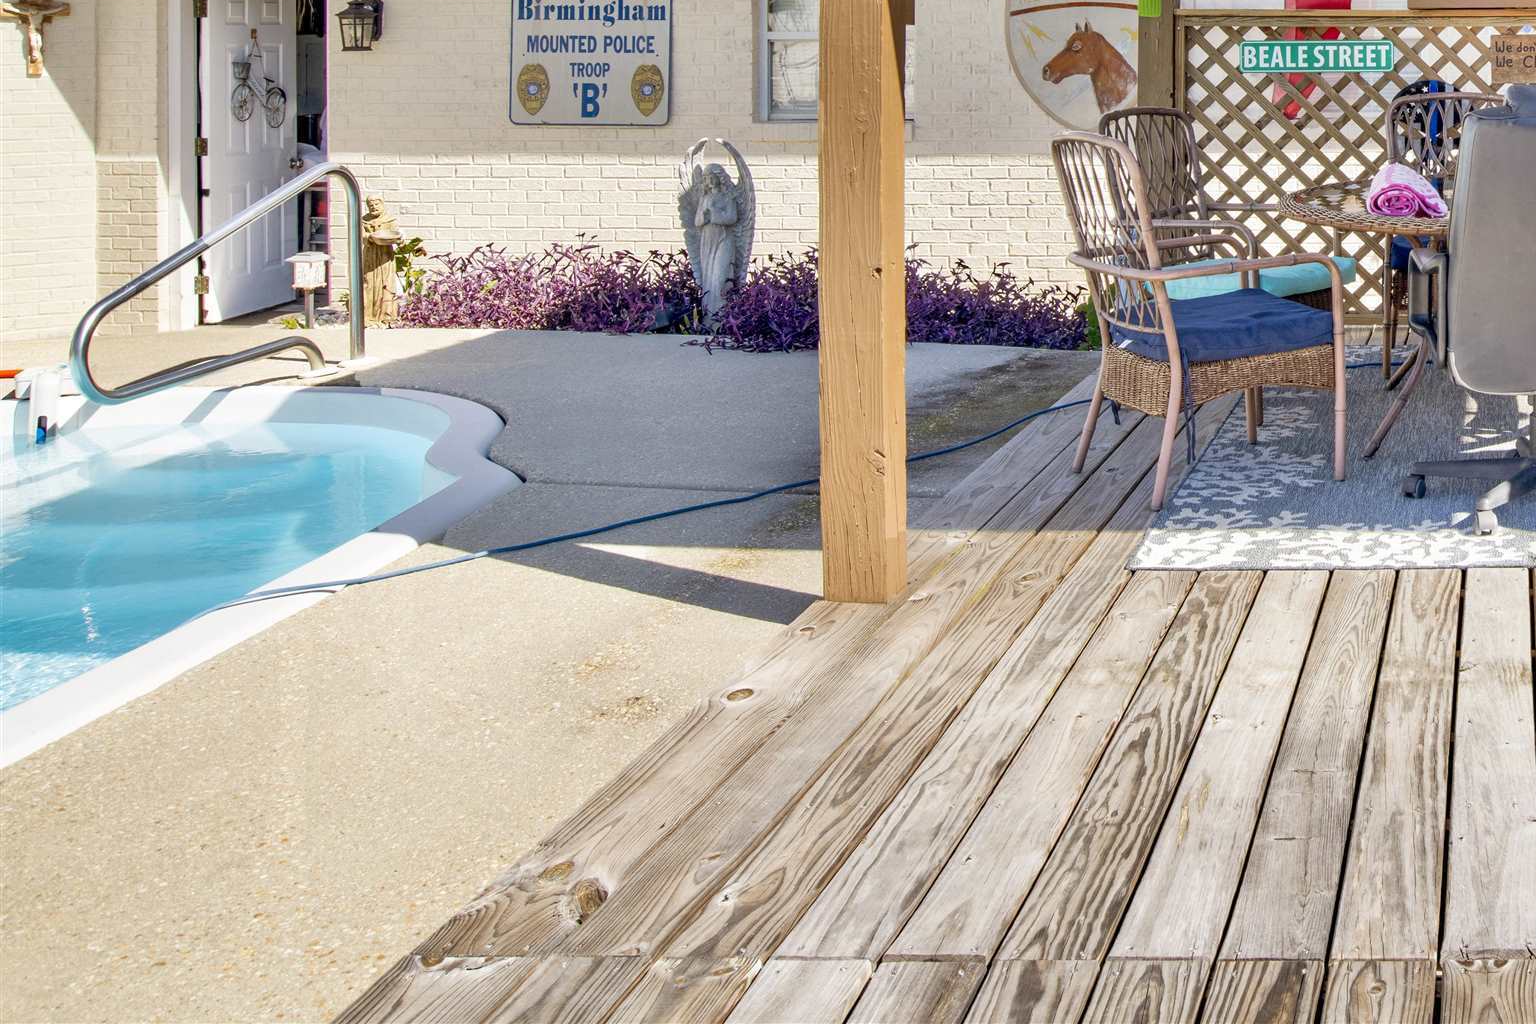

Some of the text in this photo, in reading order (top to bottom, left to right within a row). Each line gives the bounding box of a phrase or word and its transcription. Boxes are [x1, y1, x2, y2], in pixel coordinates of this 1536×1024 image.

[526, 35, 656, 54] MOUNTED POLICE
[1495, 40, 1513, 53] We
[1243, 45, 1390, 68] BEALE STREET
[1495, 55, 1513, 68] We
[569, 62, 610, 78] TROOP
